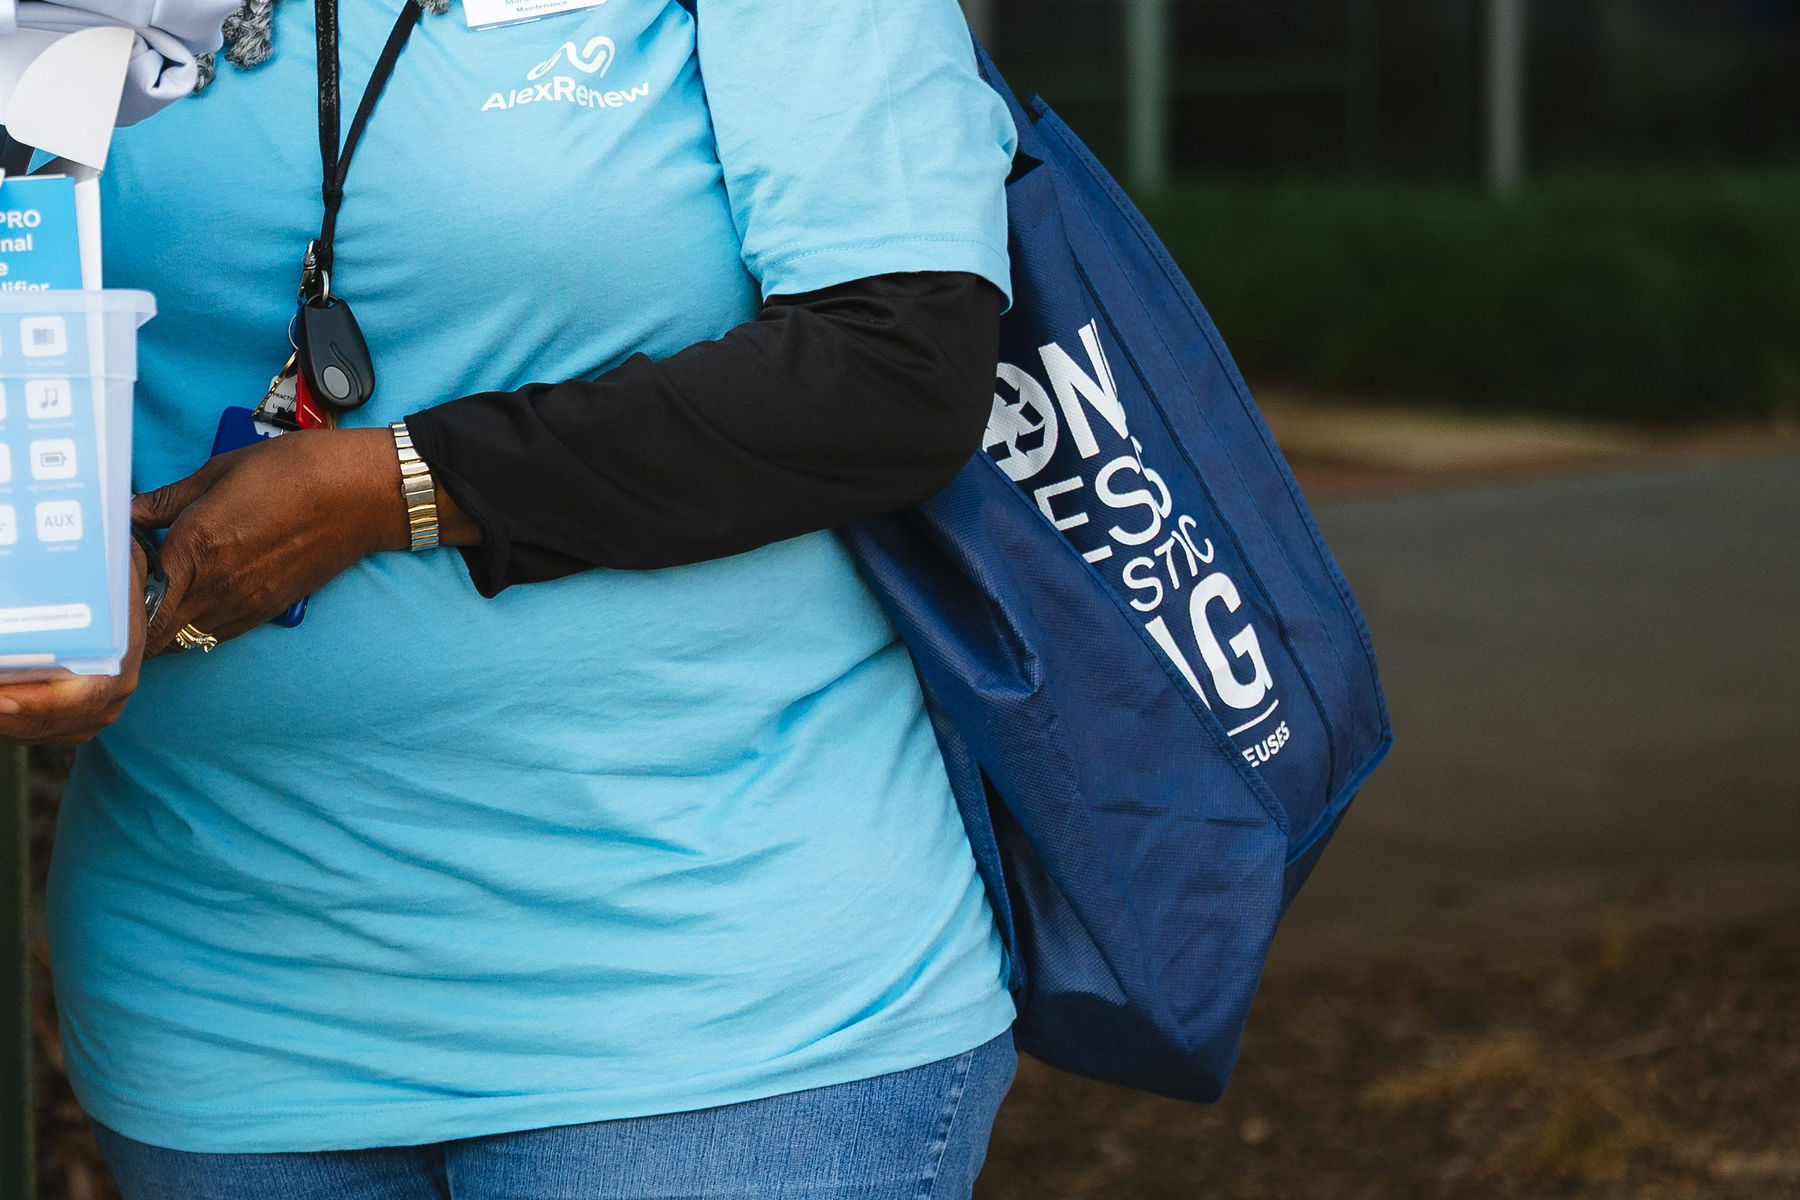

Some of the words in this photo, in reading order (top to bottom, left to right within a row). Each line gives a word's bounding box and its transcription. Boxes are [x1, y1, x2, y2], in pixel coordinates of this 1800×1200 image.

[480, 76, 649, 112] AlexRenew
[982, 318, 1128, 482] ON
[43, 514, 75, 529] AUX
[1122, 514, 1215, 612] STIC
[1241, 720, 1290, 768] EUSES
